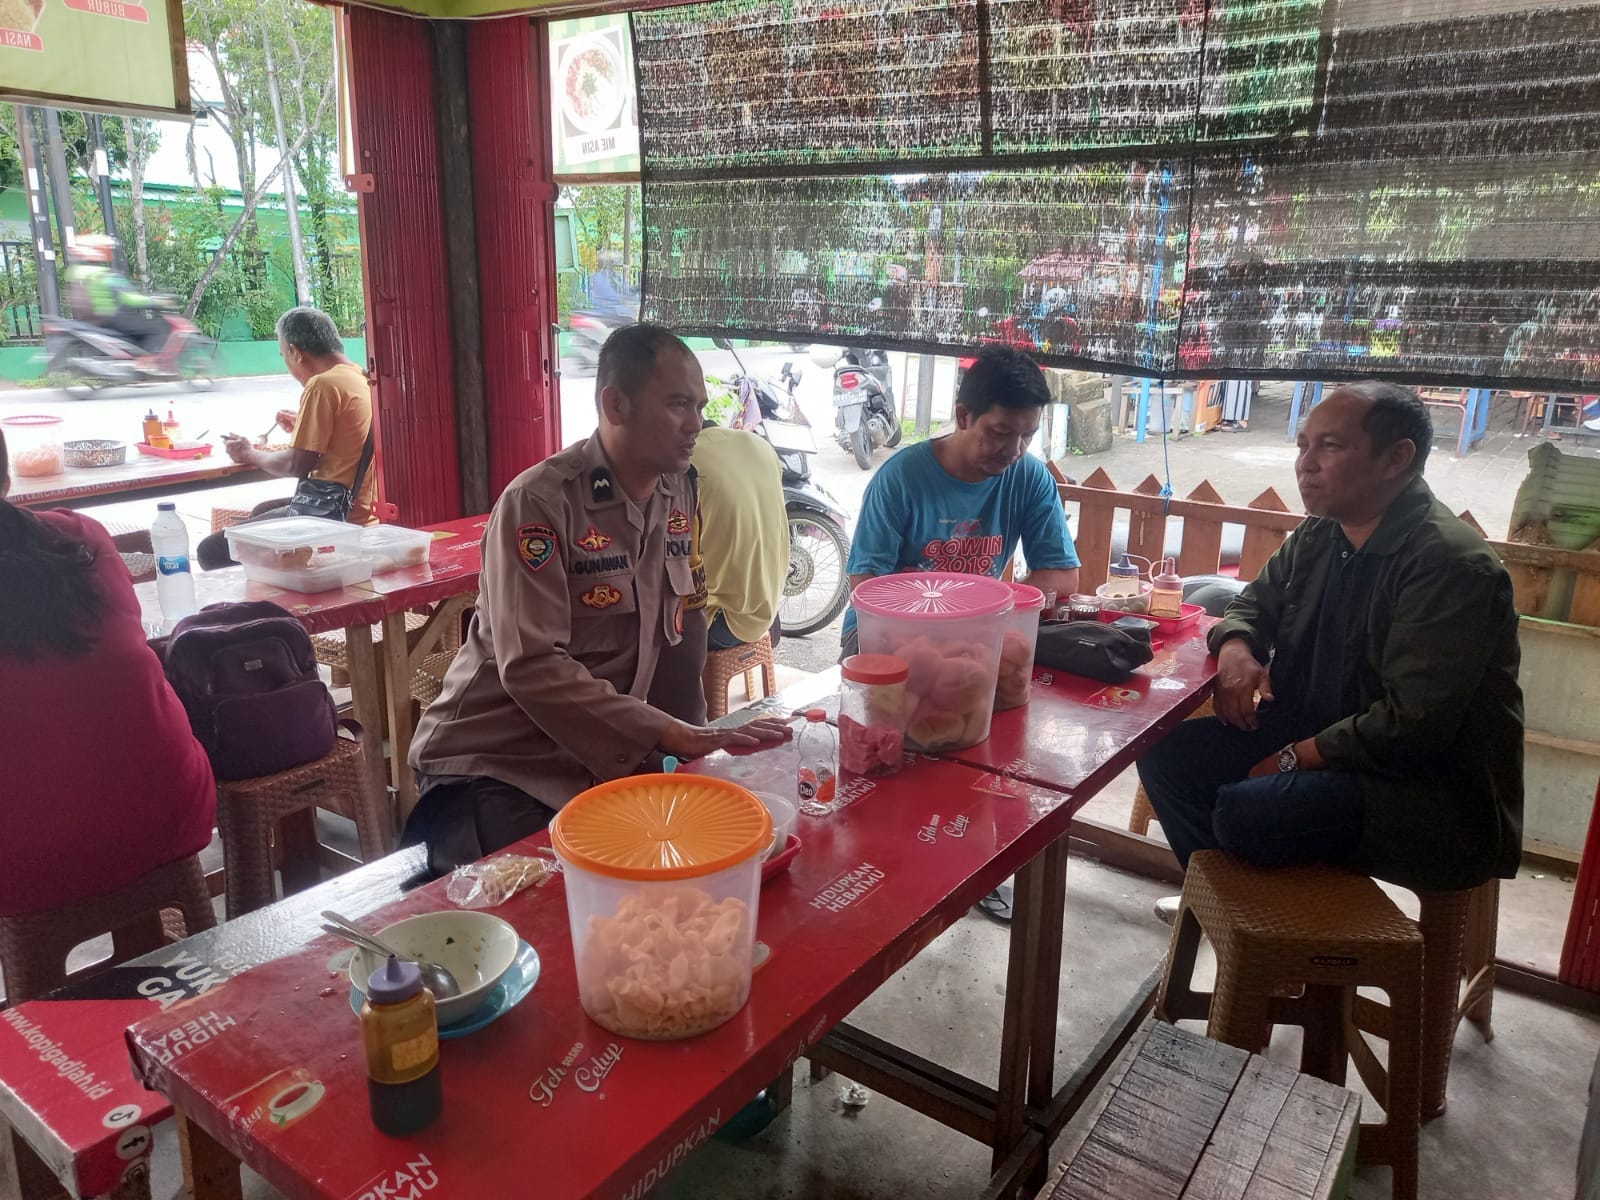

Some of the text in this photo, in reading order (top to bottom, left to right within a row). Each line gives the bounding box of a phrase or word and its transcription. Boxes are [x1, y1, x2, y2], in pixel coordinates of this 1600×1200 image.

[925, 534, 1003, 557] GOWIN
[931, 555, 992, 575] 2019
[942, 814, 970, 838] Celup
[808, 862, 876, 909] HIDUPKAN
[825, 869, 886, 913] HEBATMU
[162, 950, 229, 994] YUK
[529, 1067, 567, 1107] Teh
[575, 1043, 624, 1092] Celup
